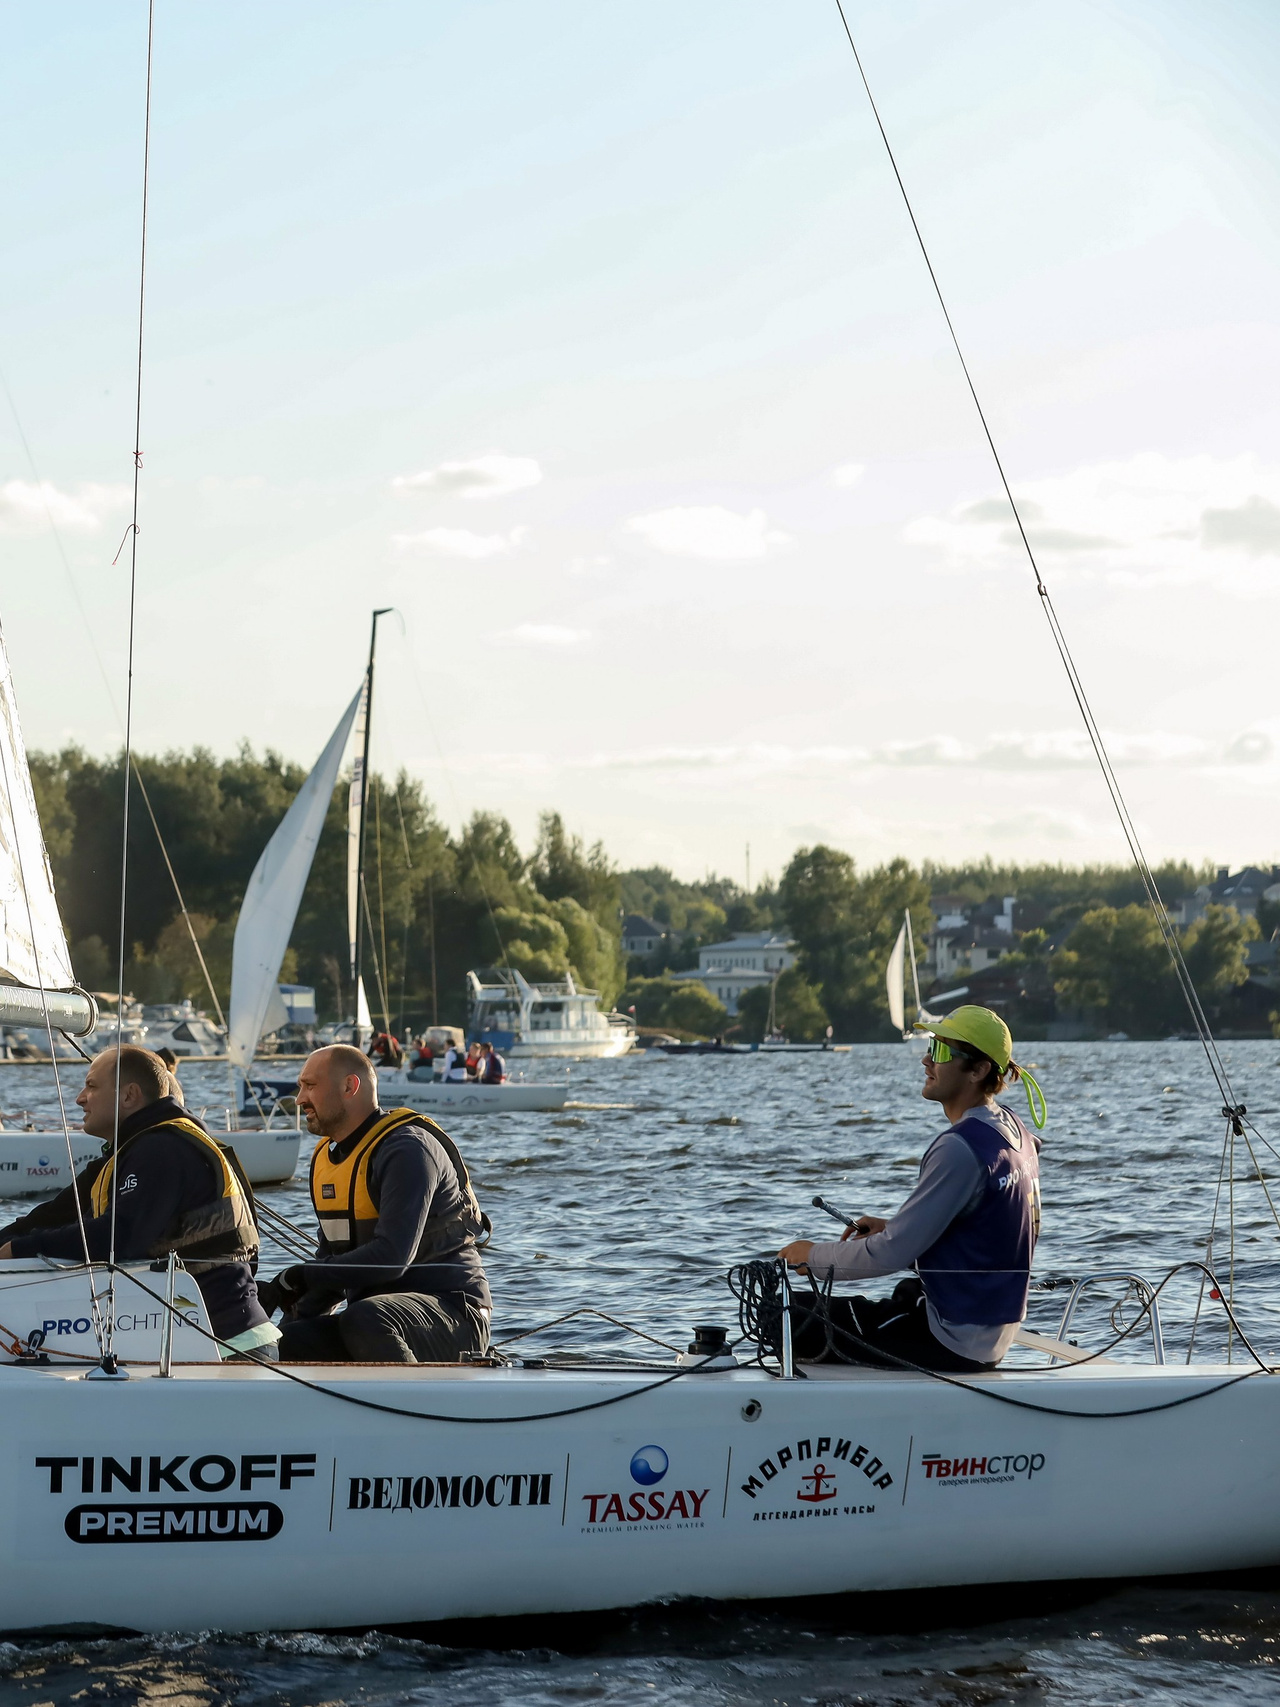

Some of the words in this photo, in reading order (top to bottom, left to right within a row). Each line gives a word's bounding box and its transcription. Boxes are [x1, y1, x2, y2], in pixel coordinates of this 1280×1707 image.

[245, 1087, 279, 1106] 22
[27, 1167, 60, 1176] TASSAY
[35, 1453, 317, 1493] TINKOFF
[740, 1436, 894, 1499] МОРПРИБОР
[938, 1478, 969, 1487] галерея
[970, 1475, 1015, 1485] интерьеров
[346, 1473, 554, 1514] ВЕДОМОСТИ
[582, 1488, 711, 1523] TASSAY
[753, 1507, 839, 1521] ЛЕГЕНДАРНЫЕ
[843, 1504, 876, 1515] ЧАСЫ
[79, 1509, 270, 1536] PREMIUM
[580, 1526, 622, 1534] PREMIUM
[626, 1524, 672, 1532] DRINKING
[676, 1521, 706, 1529] WATER
